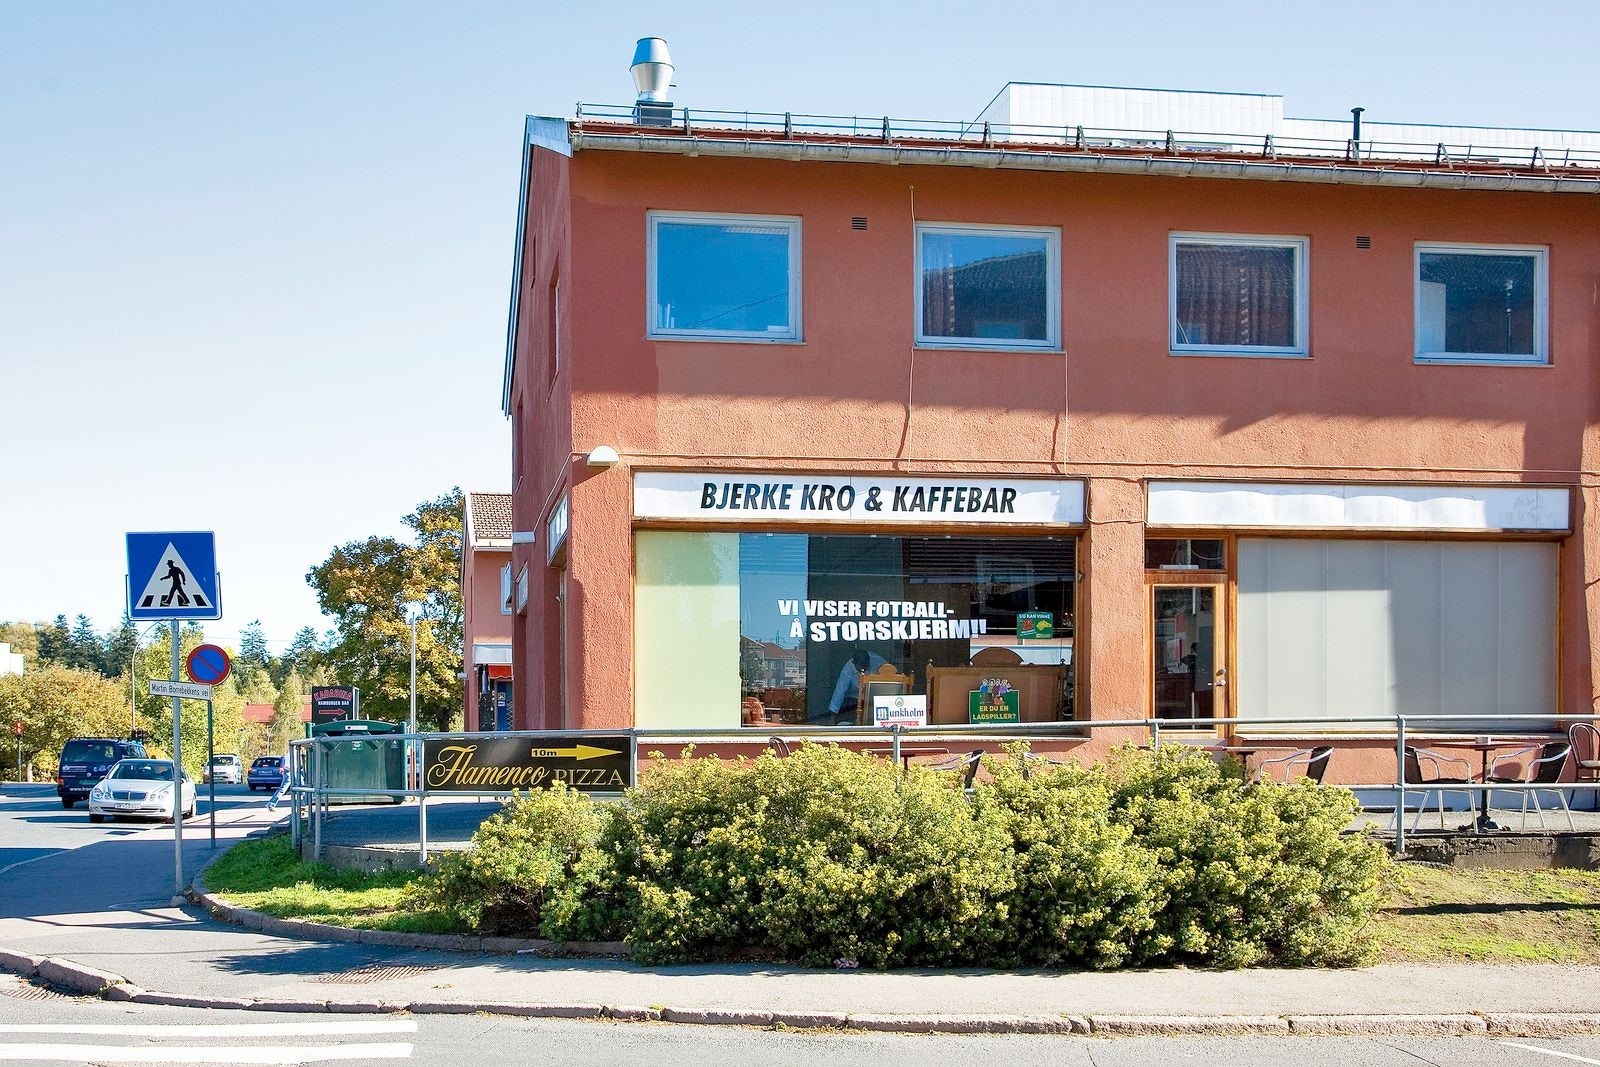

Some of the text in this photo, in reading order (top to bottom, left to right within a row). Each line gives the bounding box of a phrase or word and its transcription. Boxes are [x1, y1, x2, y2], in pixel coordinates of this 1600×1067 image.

[700, 482, 1017, 514] BJERKE KRO & KAFFEBAR
[778, 600, 955, 618] VI VISER FOTBALL-
[789, 618, 987, 642] Å STORSKJERM!!
[151, 683, 168, 693] Martin
[201, 688, 209, 697] vei
[532, 749, 558, 758] 10m
[427, 744, 625, 787] Flamenco PIZZA
